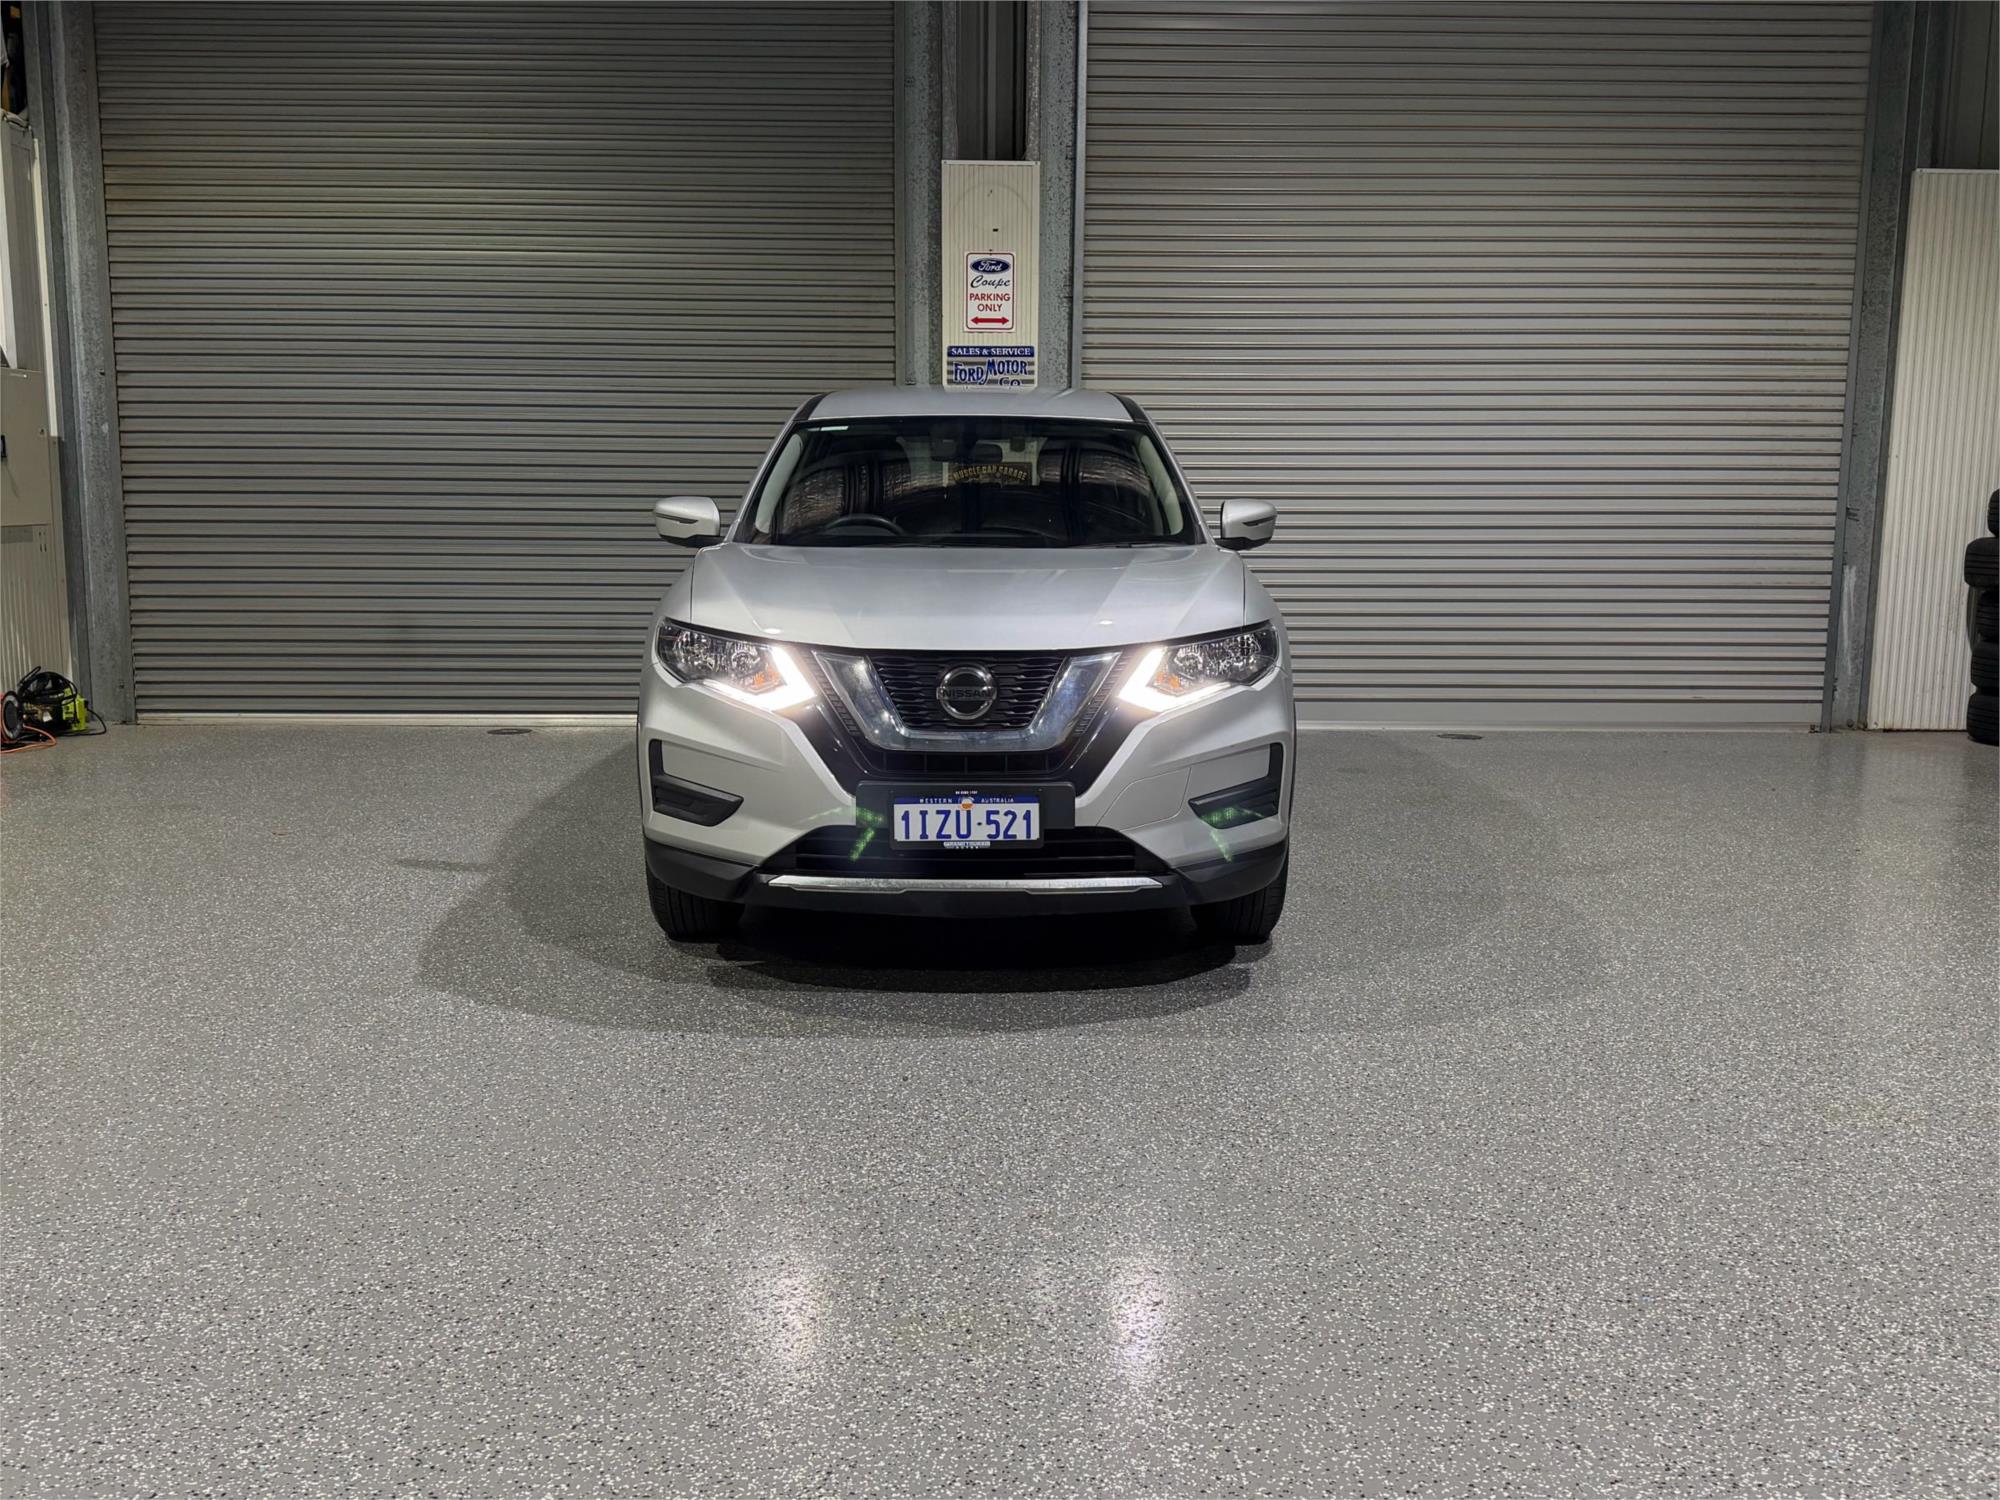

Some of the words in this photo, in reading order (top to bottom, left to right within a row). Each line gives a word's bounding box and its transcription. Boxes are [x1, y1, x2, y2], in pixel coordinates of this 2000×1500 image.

[978, 260, 1002, 271] Ford
[970, 275, 1010, 288] Coupe
[969, 293, 1011, 301] PARKING
[977, 303, 1003, 312] ONLY
[951, 347, 981, 355] SALES
[991, 347, 1031, 355] SERVICE
[953, 362, 984, 383] FORD
[982, 359, 1028, 384] MOTOR
[942, 689, 993, 698] NISSAN
